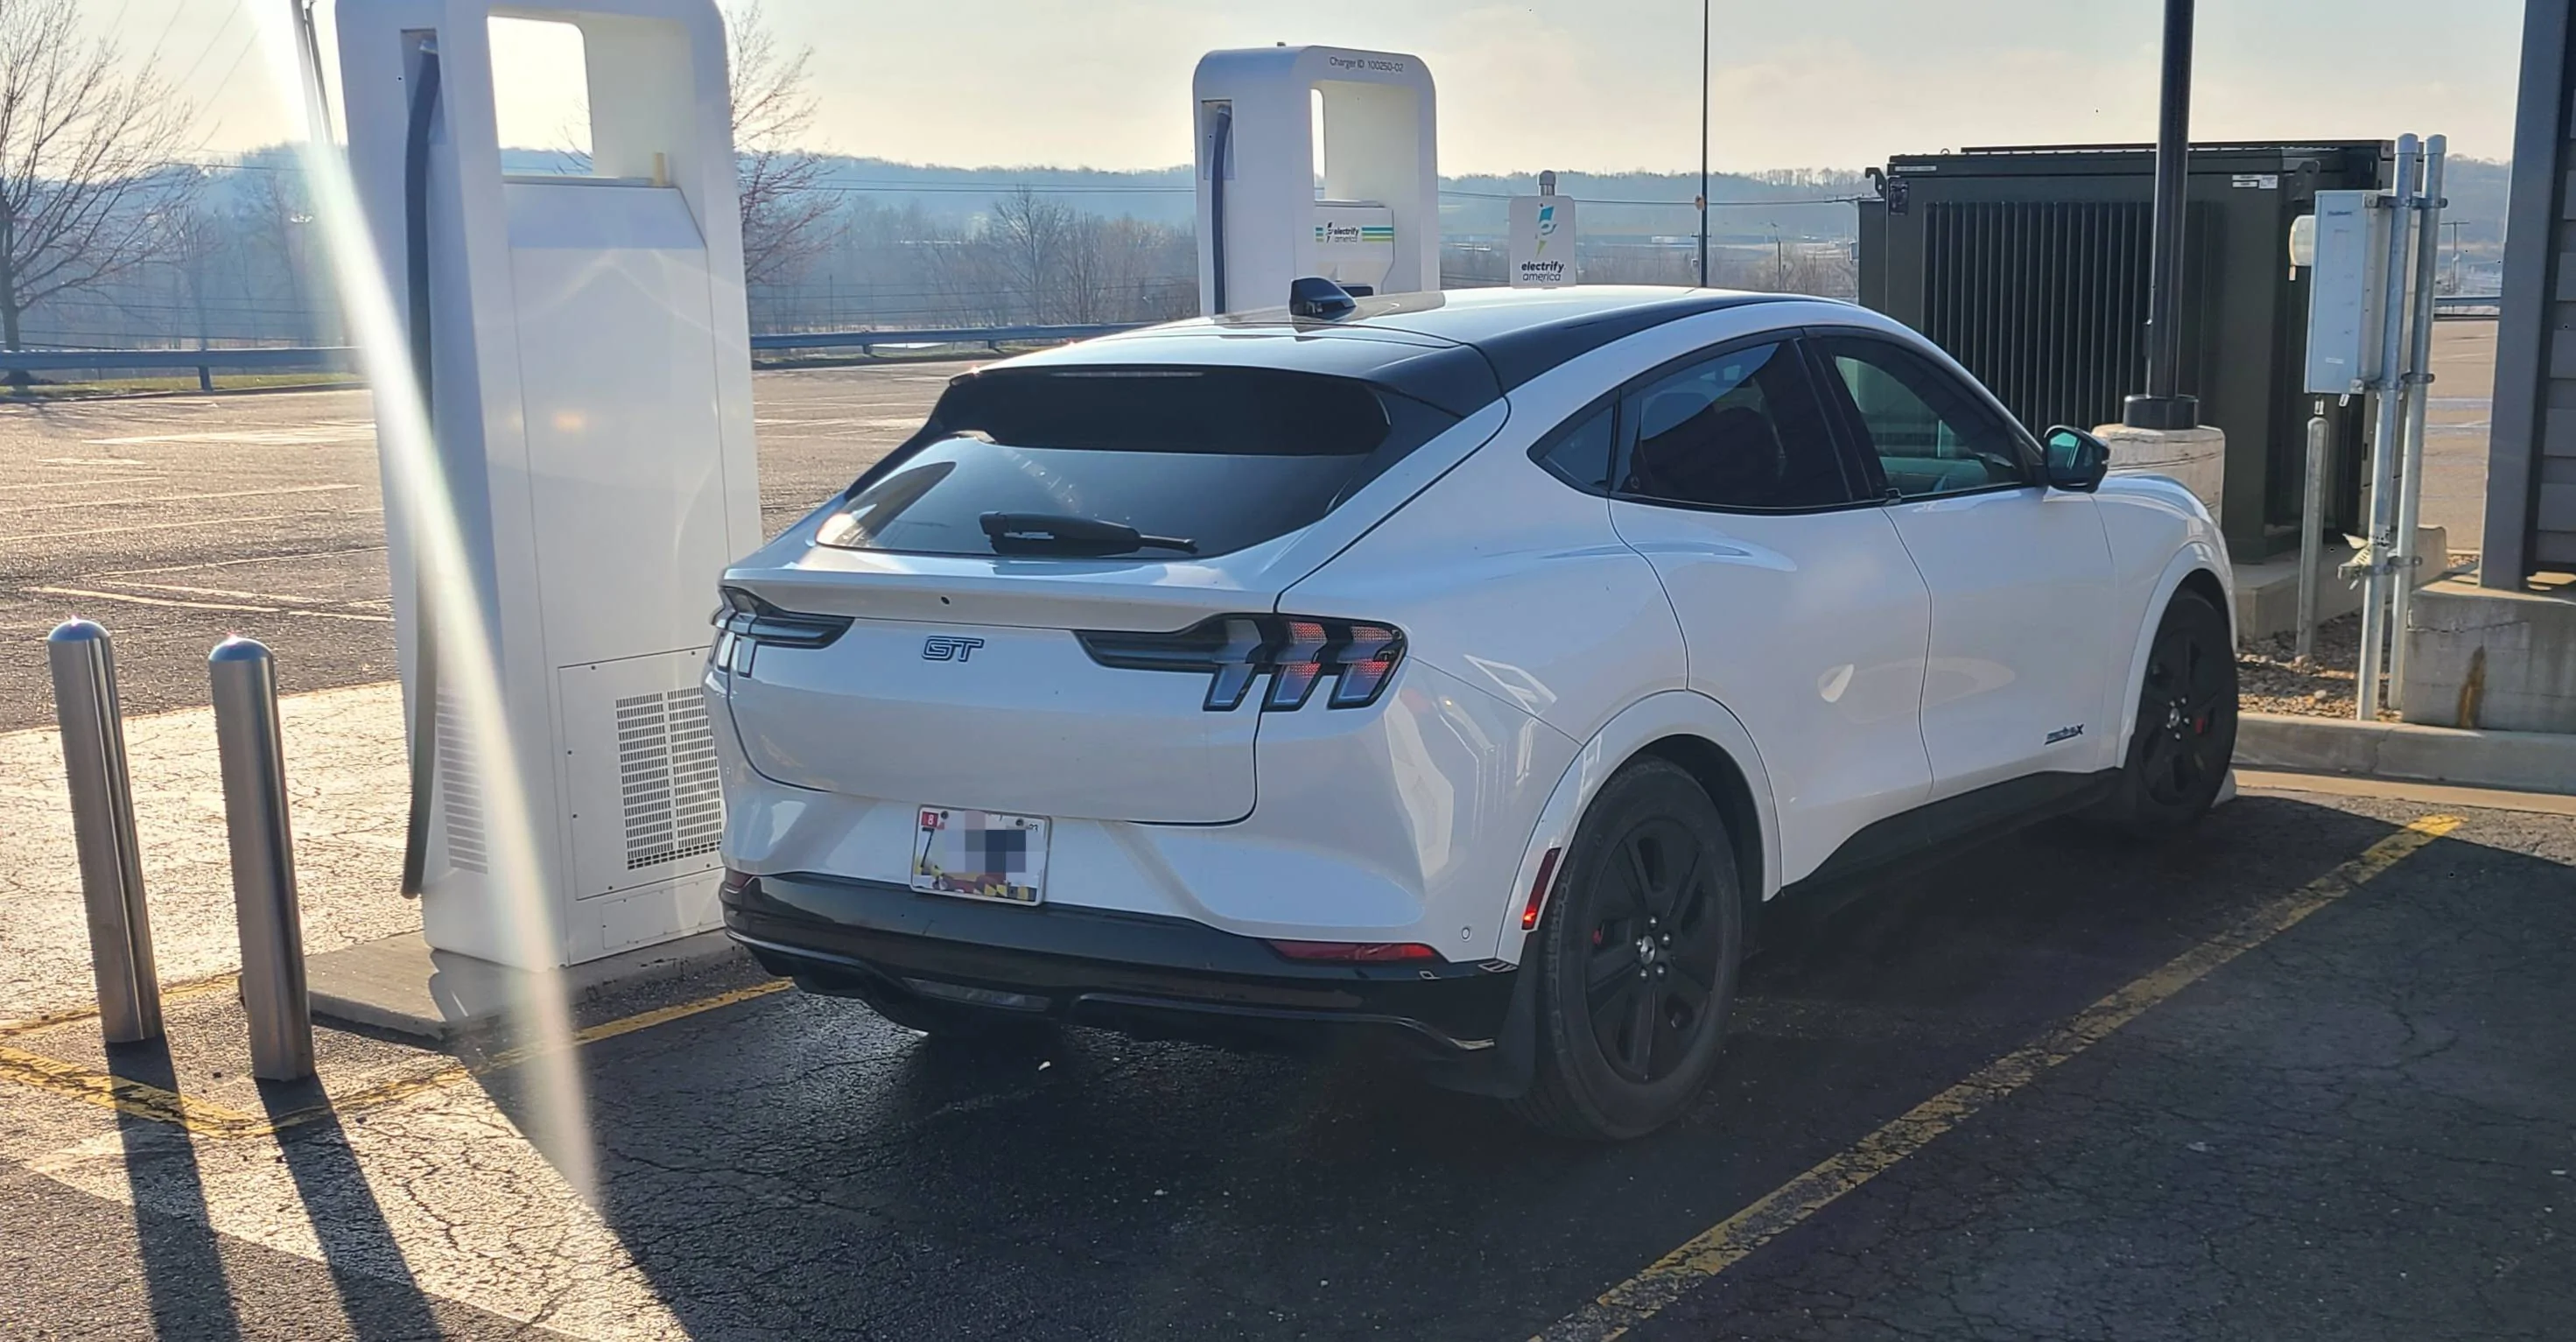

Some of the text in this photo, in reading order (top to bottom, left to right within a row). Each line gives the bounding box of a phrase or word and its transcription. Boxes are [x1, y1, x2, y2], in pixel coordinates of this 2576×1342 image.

[1329, 56, 1404, 72] Charger ID 100250-02
[1333, 227, 1359, 237] electrify
[1521, 261, 1565, 273] electrify
[1522, 271, 1562, 281] america
[921, 636, 985, 663] GT
